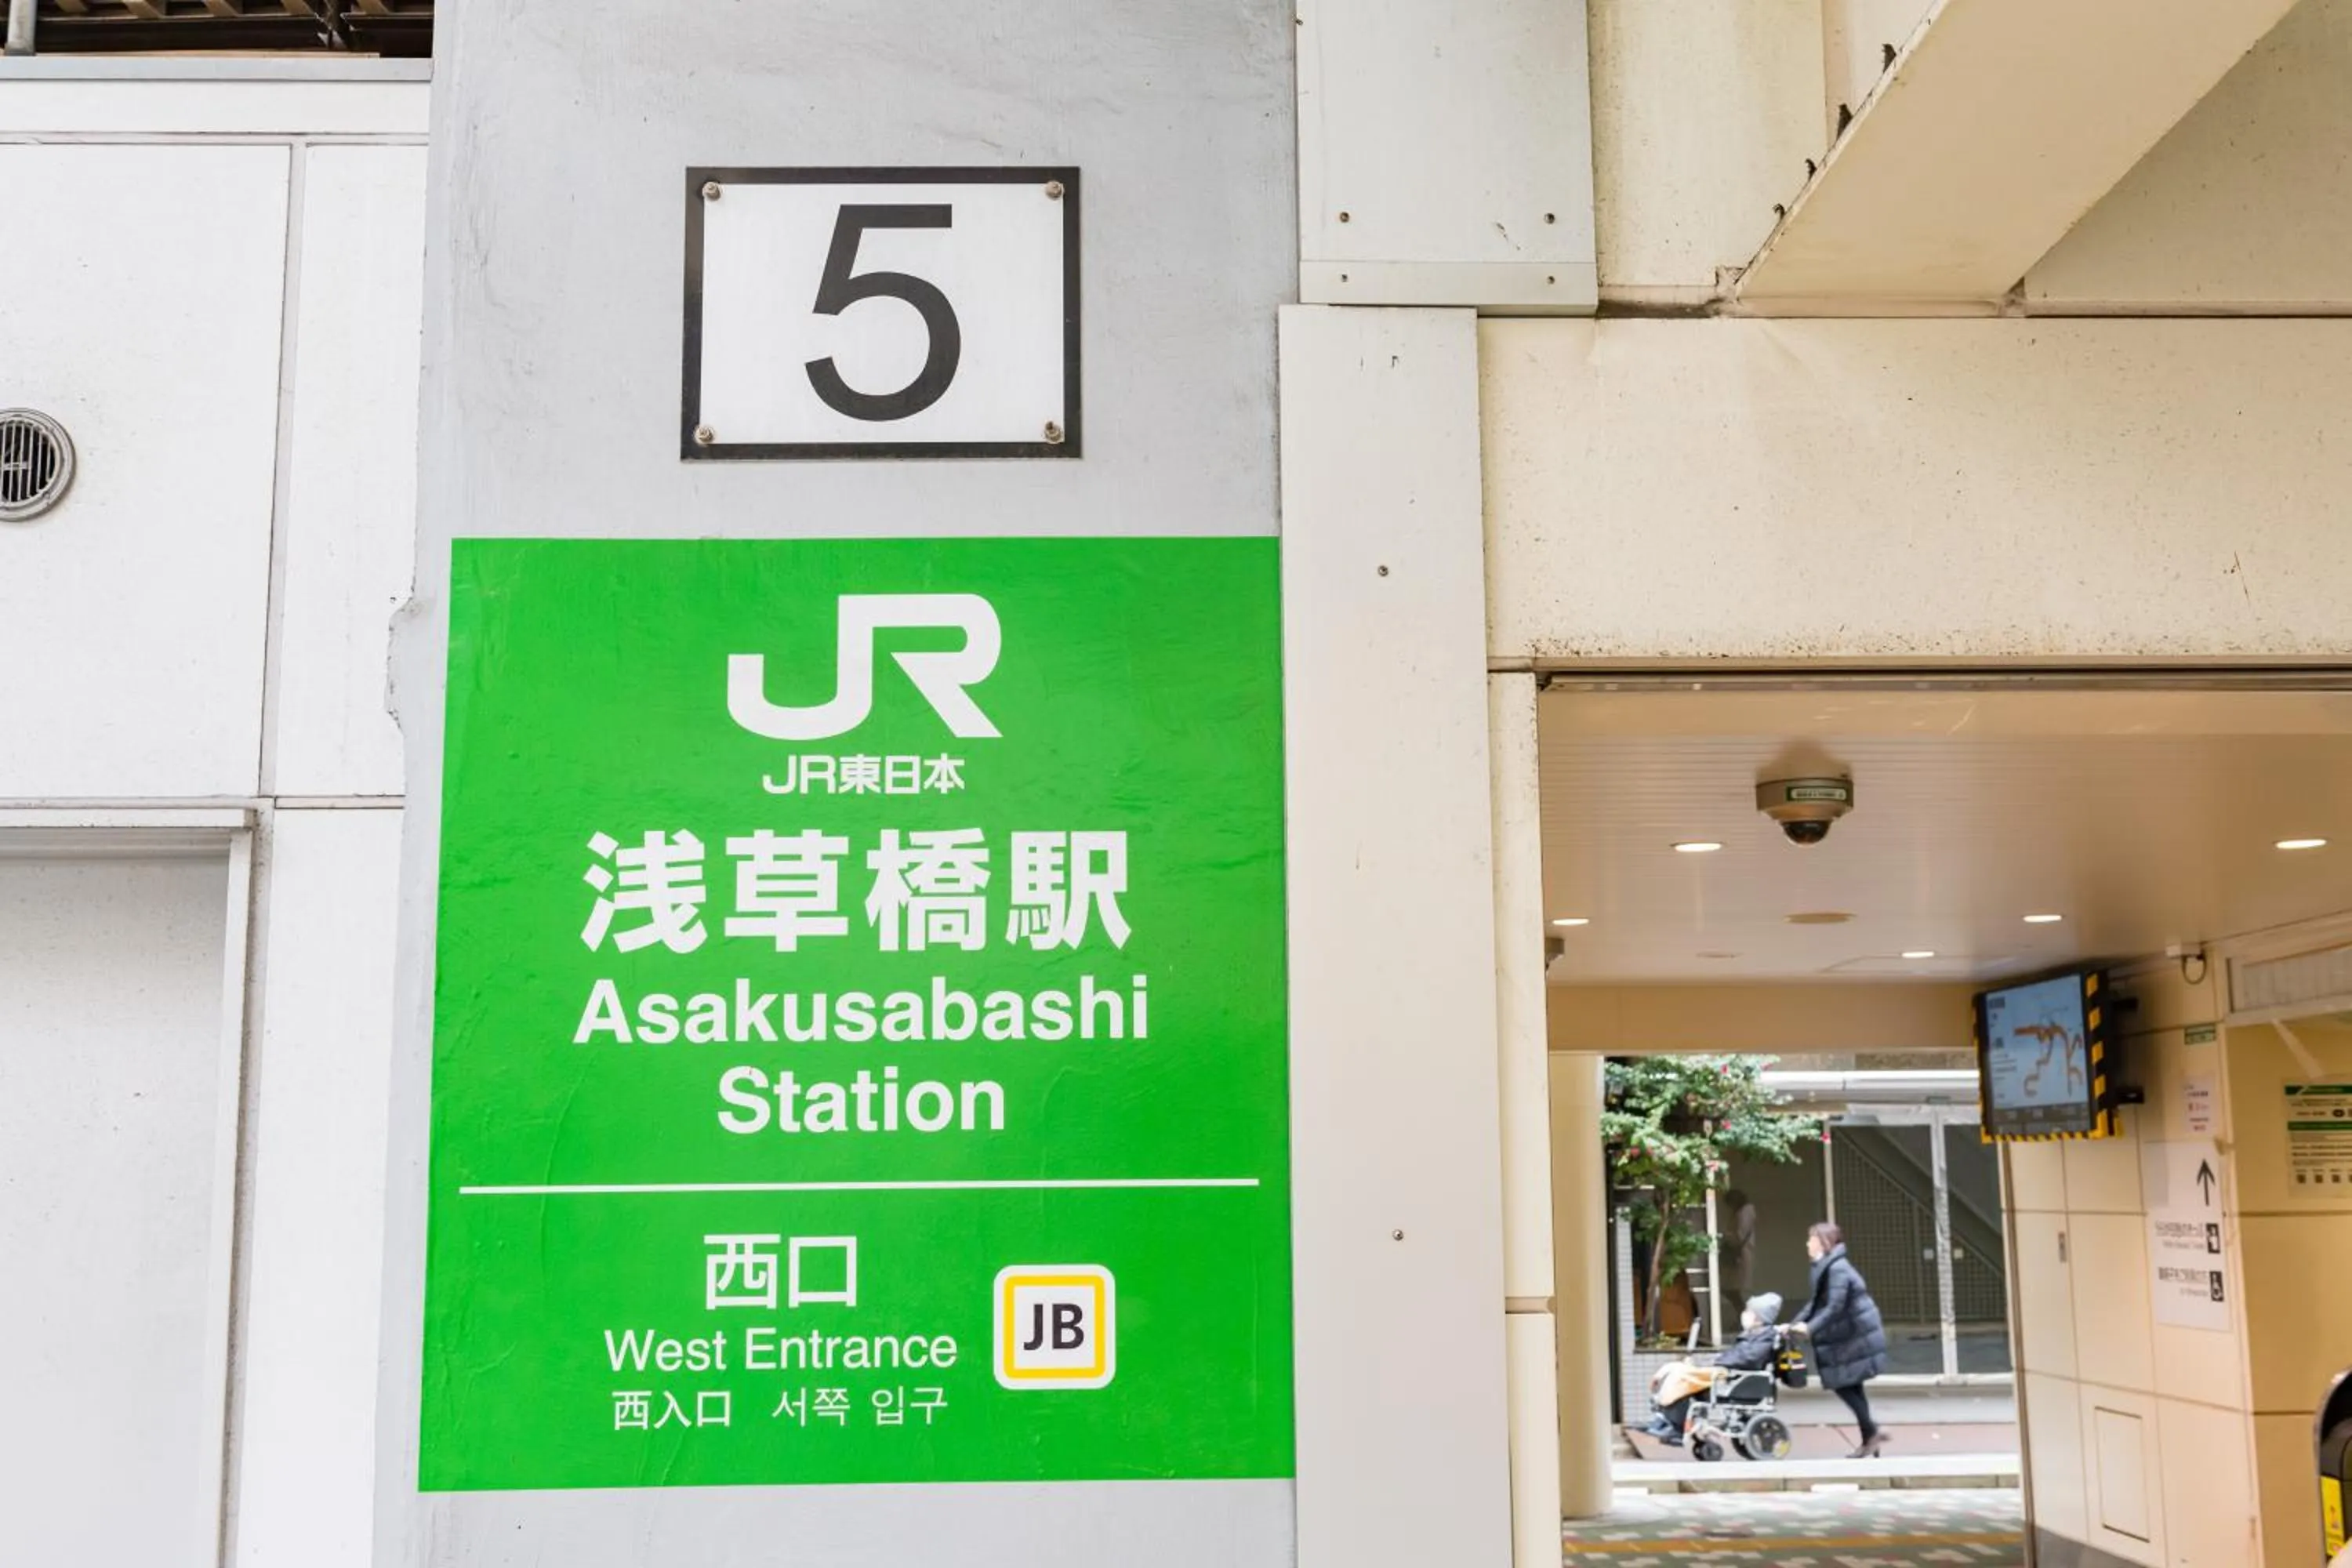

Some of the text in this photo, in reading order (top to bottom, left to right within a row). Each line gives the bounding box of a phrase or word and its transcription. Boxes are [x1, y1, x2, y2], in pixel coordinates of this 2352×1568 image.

[805, 204, 960, 422] 5
[727, 593, 1003, 741] JR
[762, 753, 966, 795] JR東日本
[580, 827, 1131, 954] 浅草橋駅
[573, 975, 1149, 1044] Asakusabashi
[717, 1065, 1005, 1134] Station
[703, 1232, 858, 1311] 西口
[604, 1327, 958, 1371] West Entrance
[1024, 1302, 1085, 1350] JB
[612, 1390, 731, 1431] 西入口
[772, 1386, 948, 1428] 서쪽 입구
